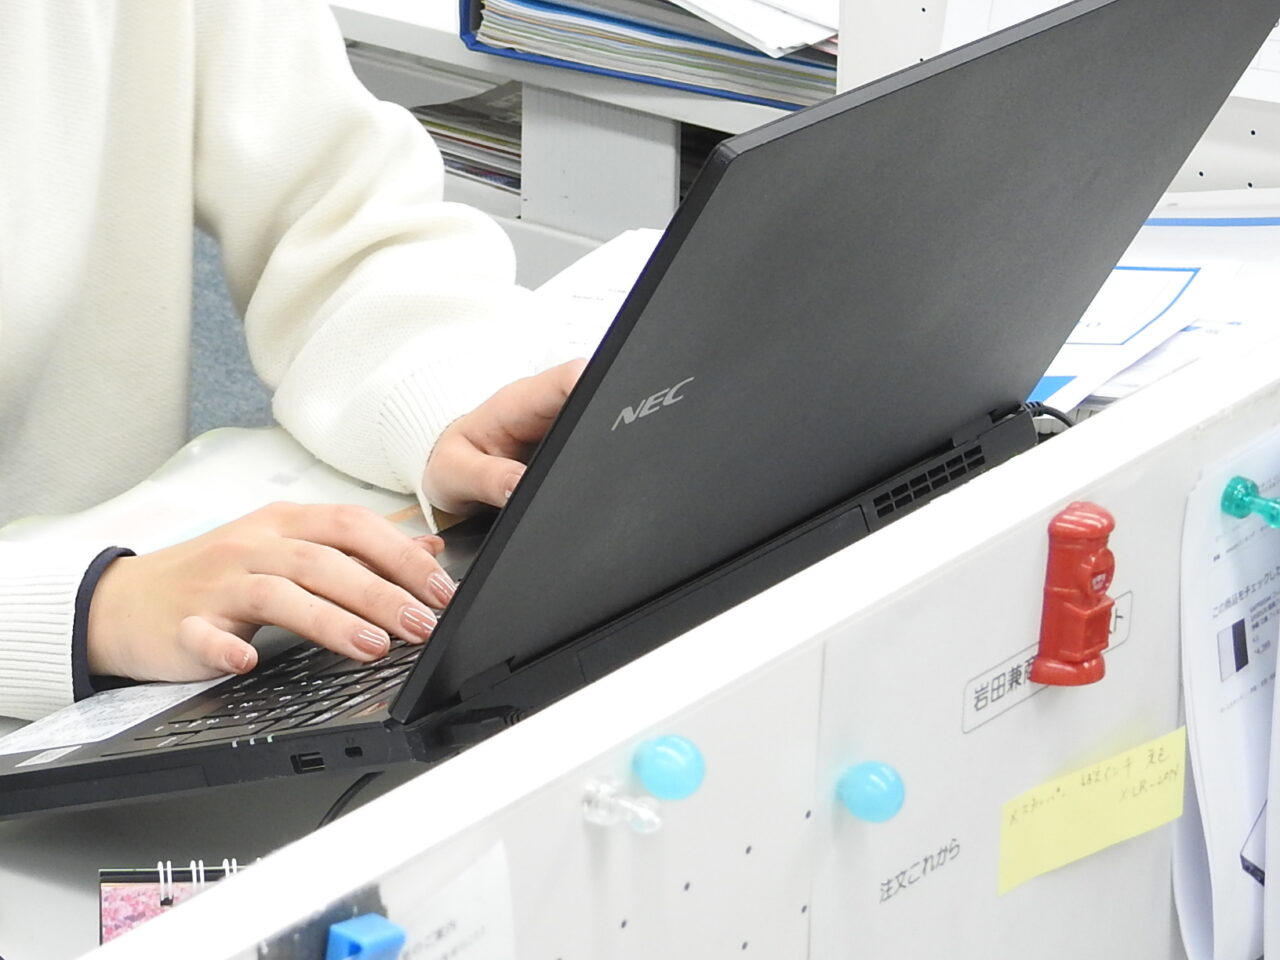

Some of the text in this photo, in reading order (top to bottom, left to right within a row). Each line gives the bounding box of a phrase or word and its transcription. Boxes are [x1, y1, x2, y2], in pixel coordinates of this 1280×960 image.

[611, 377, 695, 431] NEC
[880, 838, 960, 904] 注文これから
